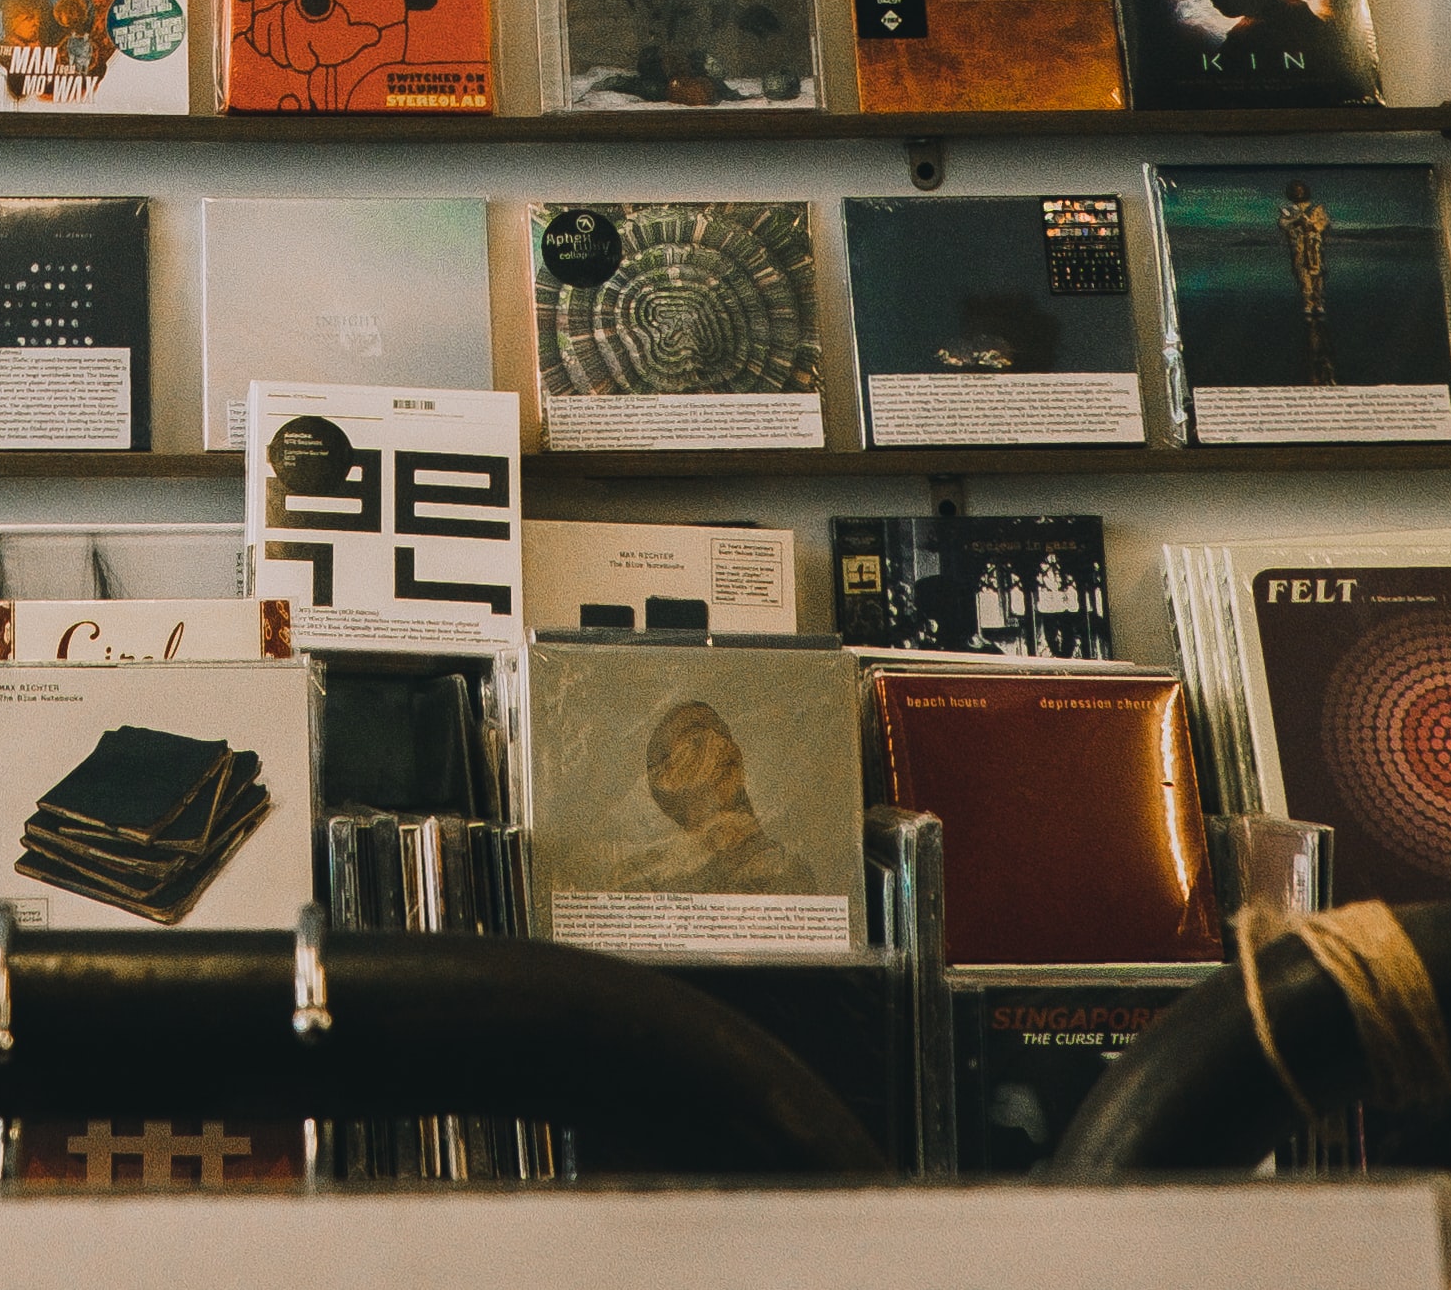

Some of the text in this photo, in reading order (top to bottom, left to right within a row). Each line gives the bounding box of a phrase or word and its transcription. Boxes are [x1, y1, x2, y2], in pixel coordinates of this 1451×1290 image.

[9, 46, 59, 75] MAN
[1202, 51, 1305, 71] KIN
[387, 72, 485, 84] SWITCHED ON
[387, 83, 457, 95] VOLUMES
[386, 94, 487, 109] STEREOLAB
[619, 551, 675, 562] MAX RICHTER
[1266, 578, 1359, 604] FELT
[21, 683, 60, 692] RICHTER
[16, 694, 37, 702] Blue
[906, 696, 1161, 713] beach house depression cherry
[1023, 1031, 1105, 1046] THE CURSE
